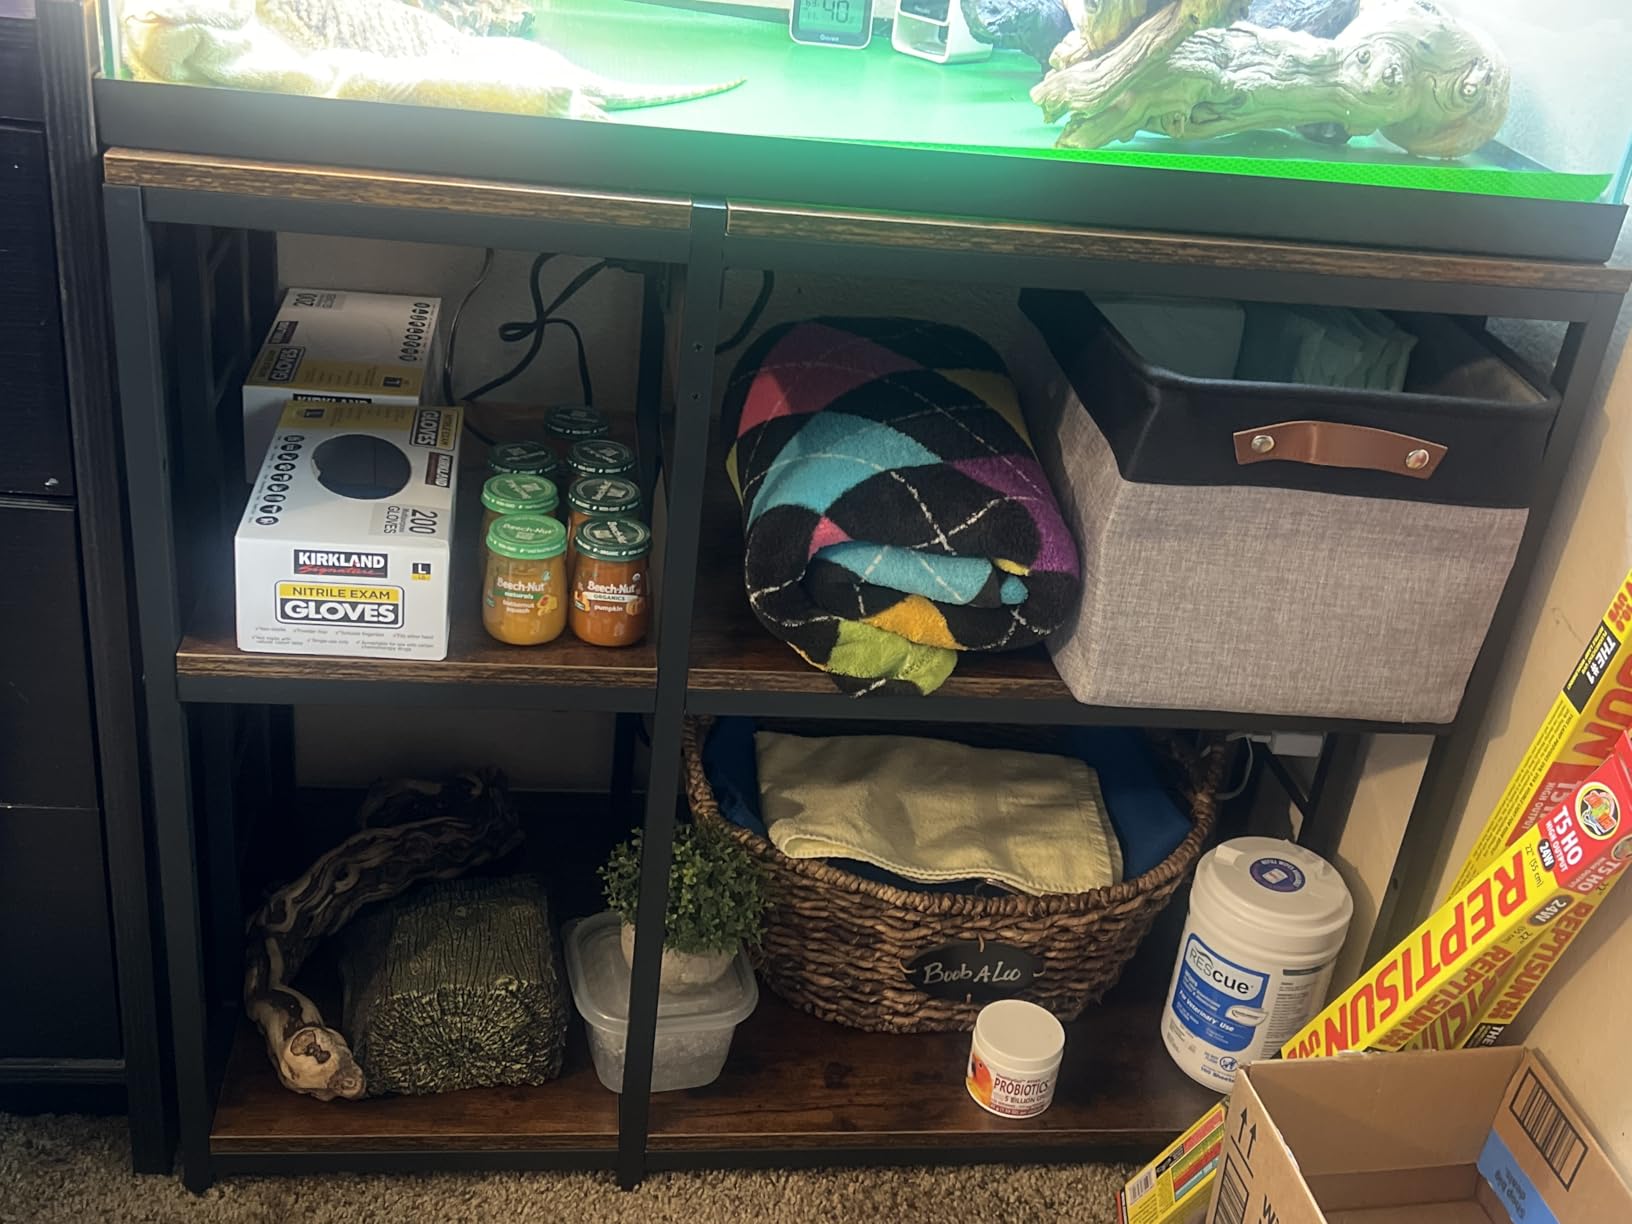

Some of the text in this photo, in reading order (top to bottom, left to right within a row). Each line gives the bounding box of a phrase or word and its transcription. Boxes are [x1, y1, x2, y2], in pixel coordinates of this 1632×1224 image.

[418, 410, 439, 446] GLOVES
[435, 455, 449, 487] KIRKLAND
[384, 505, 400, 534] GLOVES
[409, 508, 438, 535] 200
[502, 522, 553, 536] Beech-Nut
[298, 551, 386, 569] KIRKLAND
[417, 563, 427, 574] L
[292, 586, 391, 600] NITRILE EXAM
[496, 576, 546, 593] Beech-Nut
[587, 580, 636, 594] Beech-Nut
[593, 594, 626, 602] ORGANICS
[593, 604, 624, 613] pumpkin
[284, 599, 396, 623] GLOVES
[1586, 635, 1616, 686] THE #1
[1545, 820, 1568, 873] HIGH OUTPUT
[1553, 805, 1583, 866] T5 HO
[1539, 842, 1555, 867] 24W
[1577, 857, 1621, 892] T5 HO
[1534, 899, 1568, 923] 24W
[1325, 850, 1528, 1056] REPTISUN
[1504, 901, 1595, 1003] REPTISUN
[1401, 944, 1513, 1033] REPTISUN
[1186, 997, 1217, 1026] Veterinary
[1219, 1020, 1235, 1032] Use
[1482, 1025, 1504, 1047] THE
[993, 1077, 1050, 1097] PROBIOTICS
[1010, 1096, 1036, 1105] BILLION
